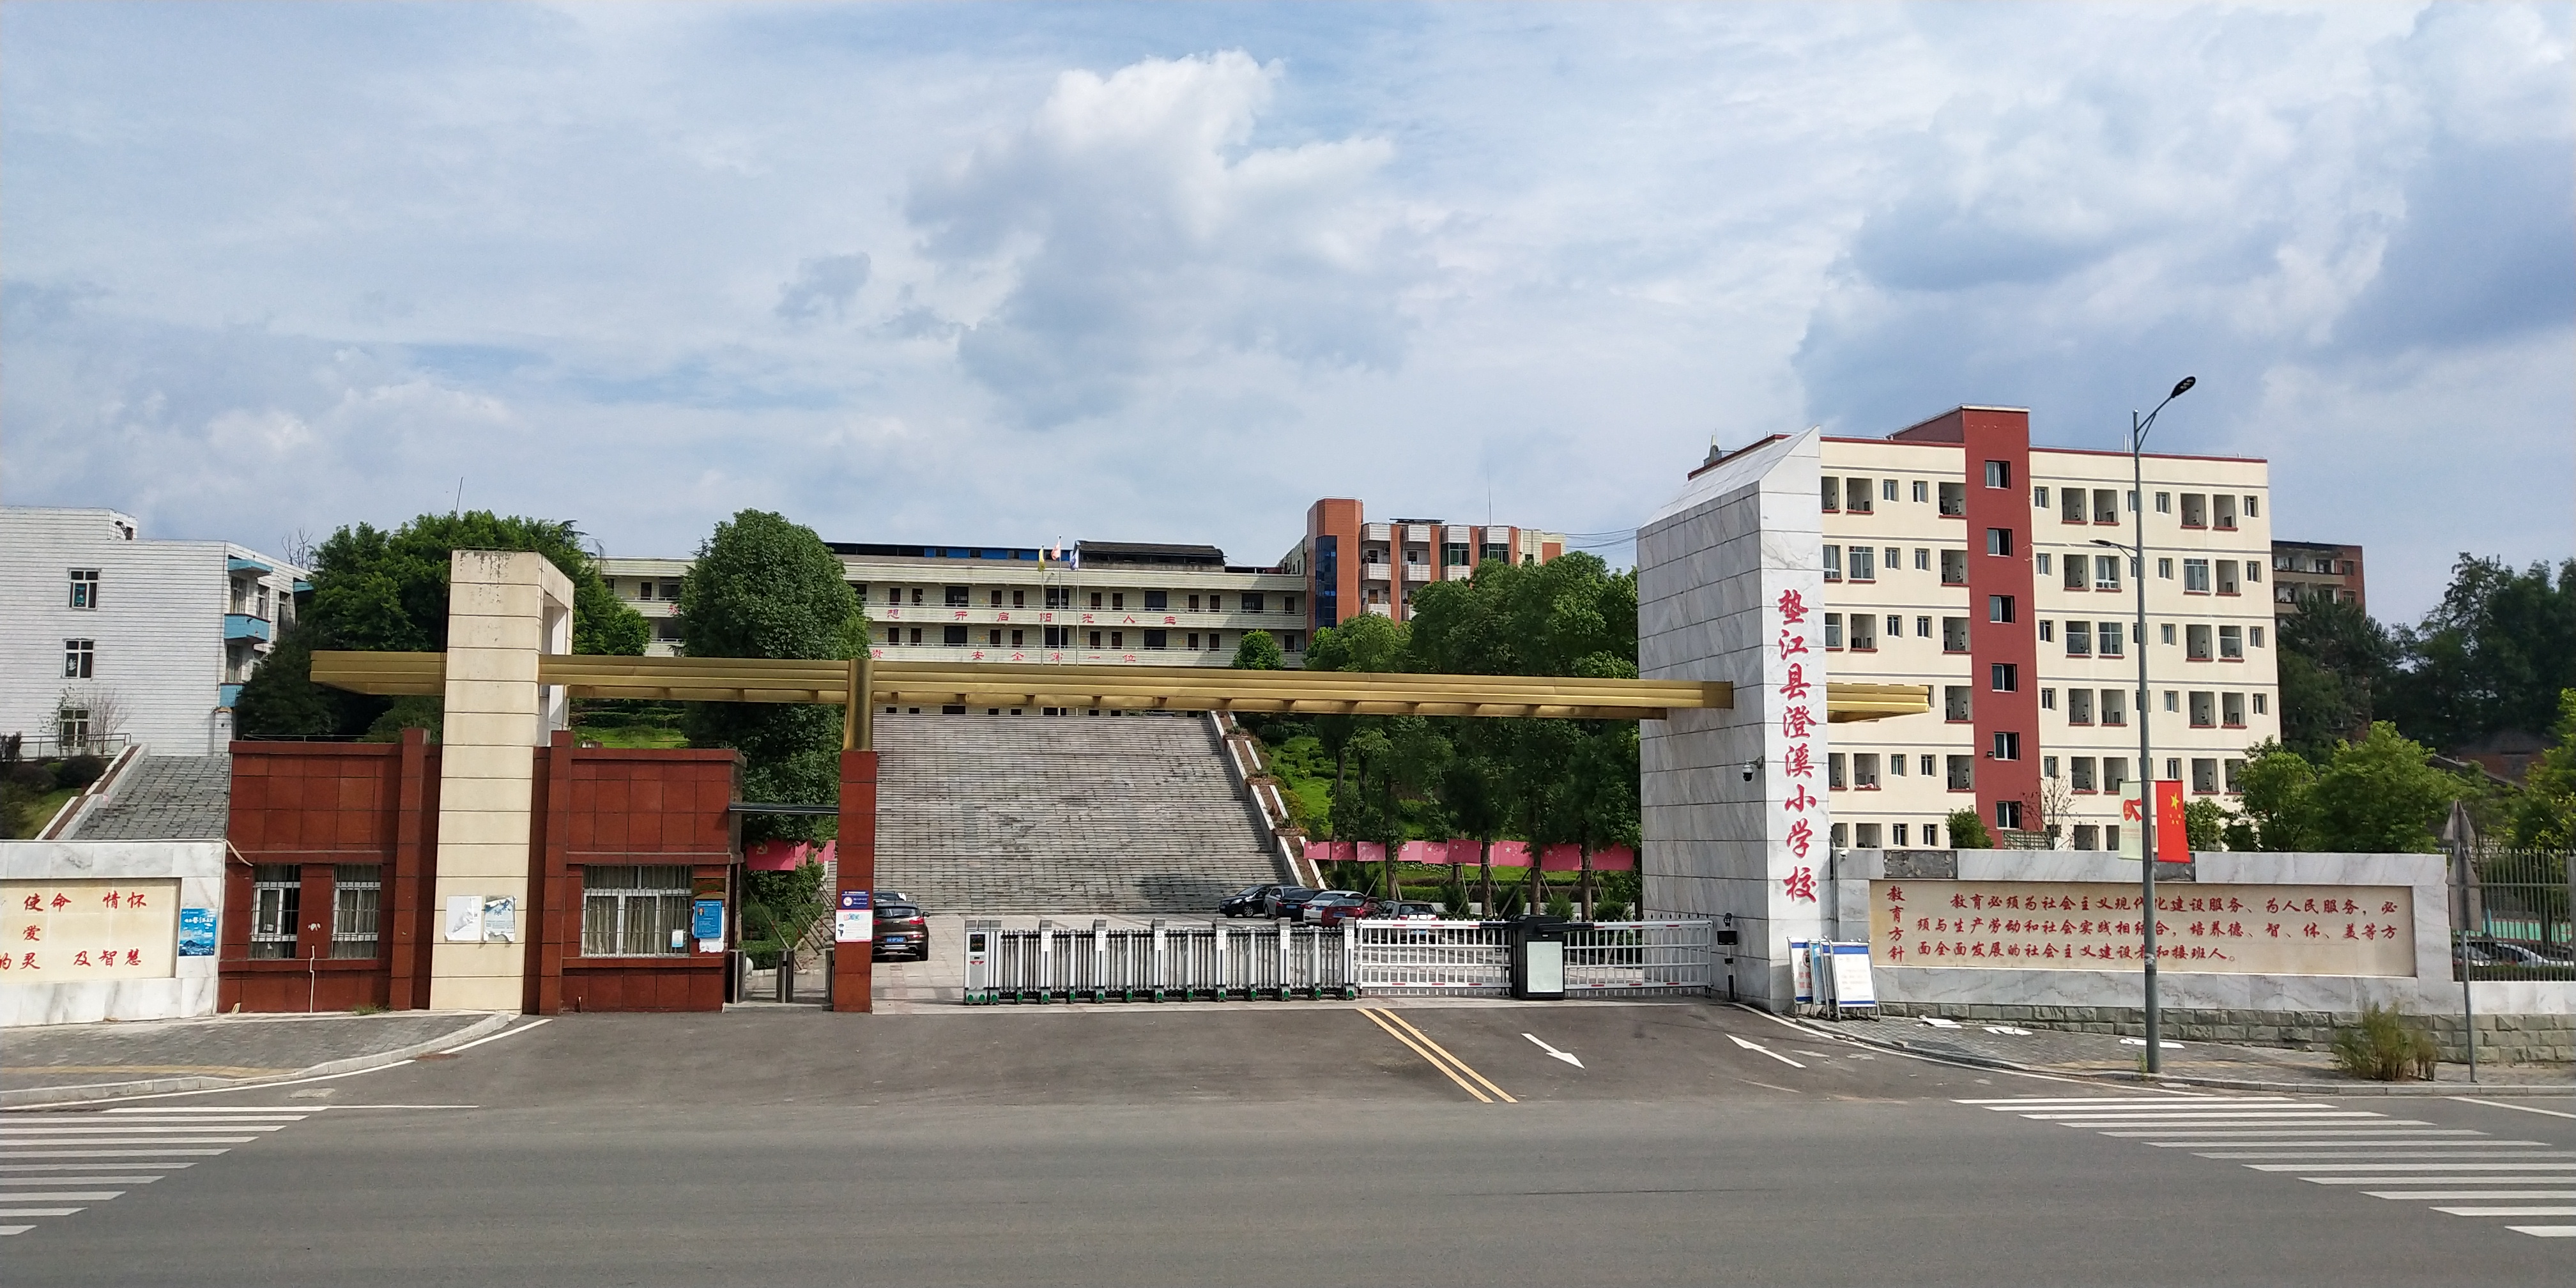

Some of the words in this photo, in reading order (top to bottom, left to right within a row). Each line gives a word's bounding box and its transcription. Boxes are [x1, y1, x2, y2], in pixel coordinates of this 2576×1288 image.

[887, 609, 900, 619] 想
[1777, 588, 1818, 903] 垫江县澄溪小学校
[24, 893, 72, 912] 使命
[102, 891, 147, 910] 情怀
[23, 924, 41, 942] 爱
[0, 951, 41, 970] 的灵
[73, 948, 142, 967] 及智慧
